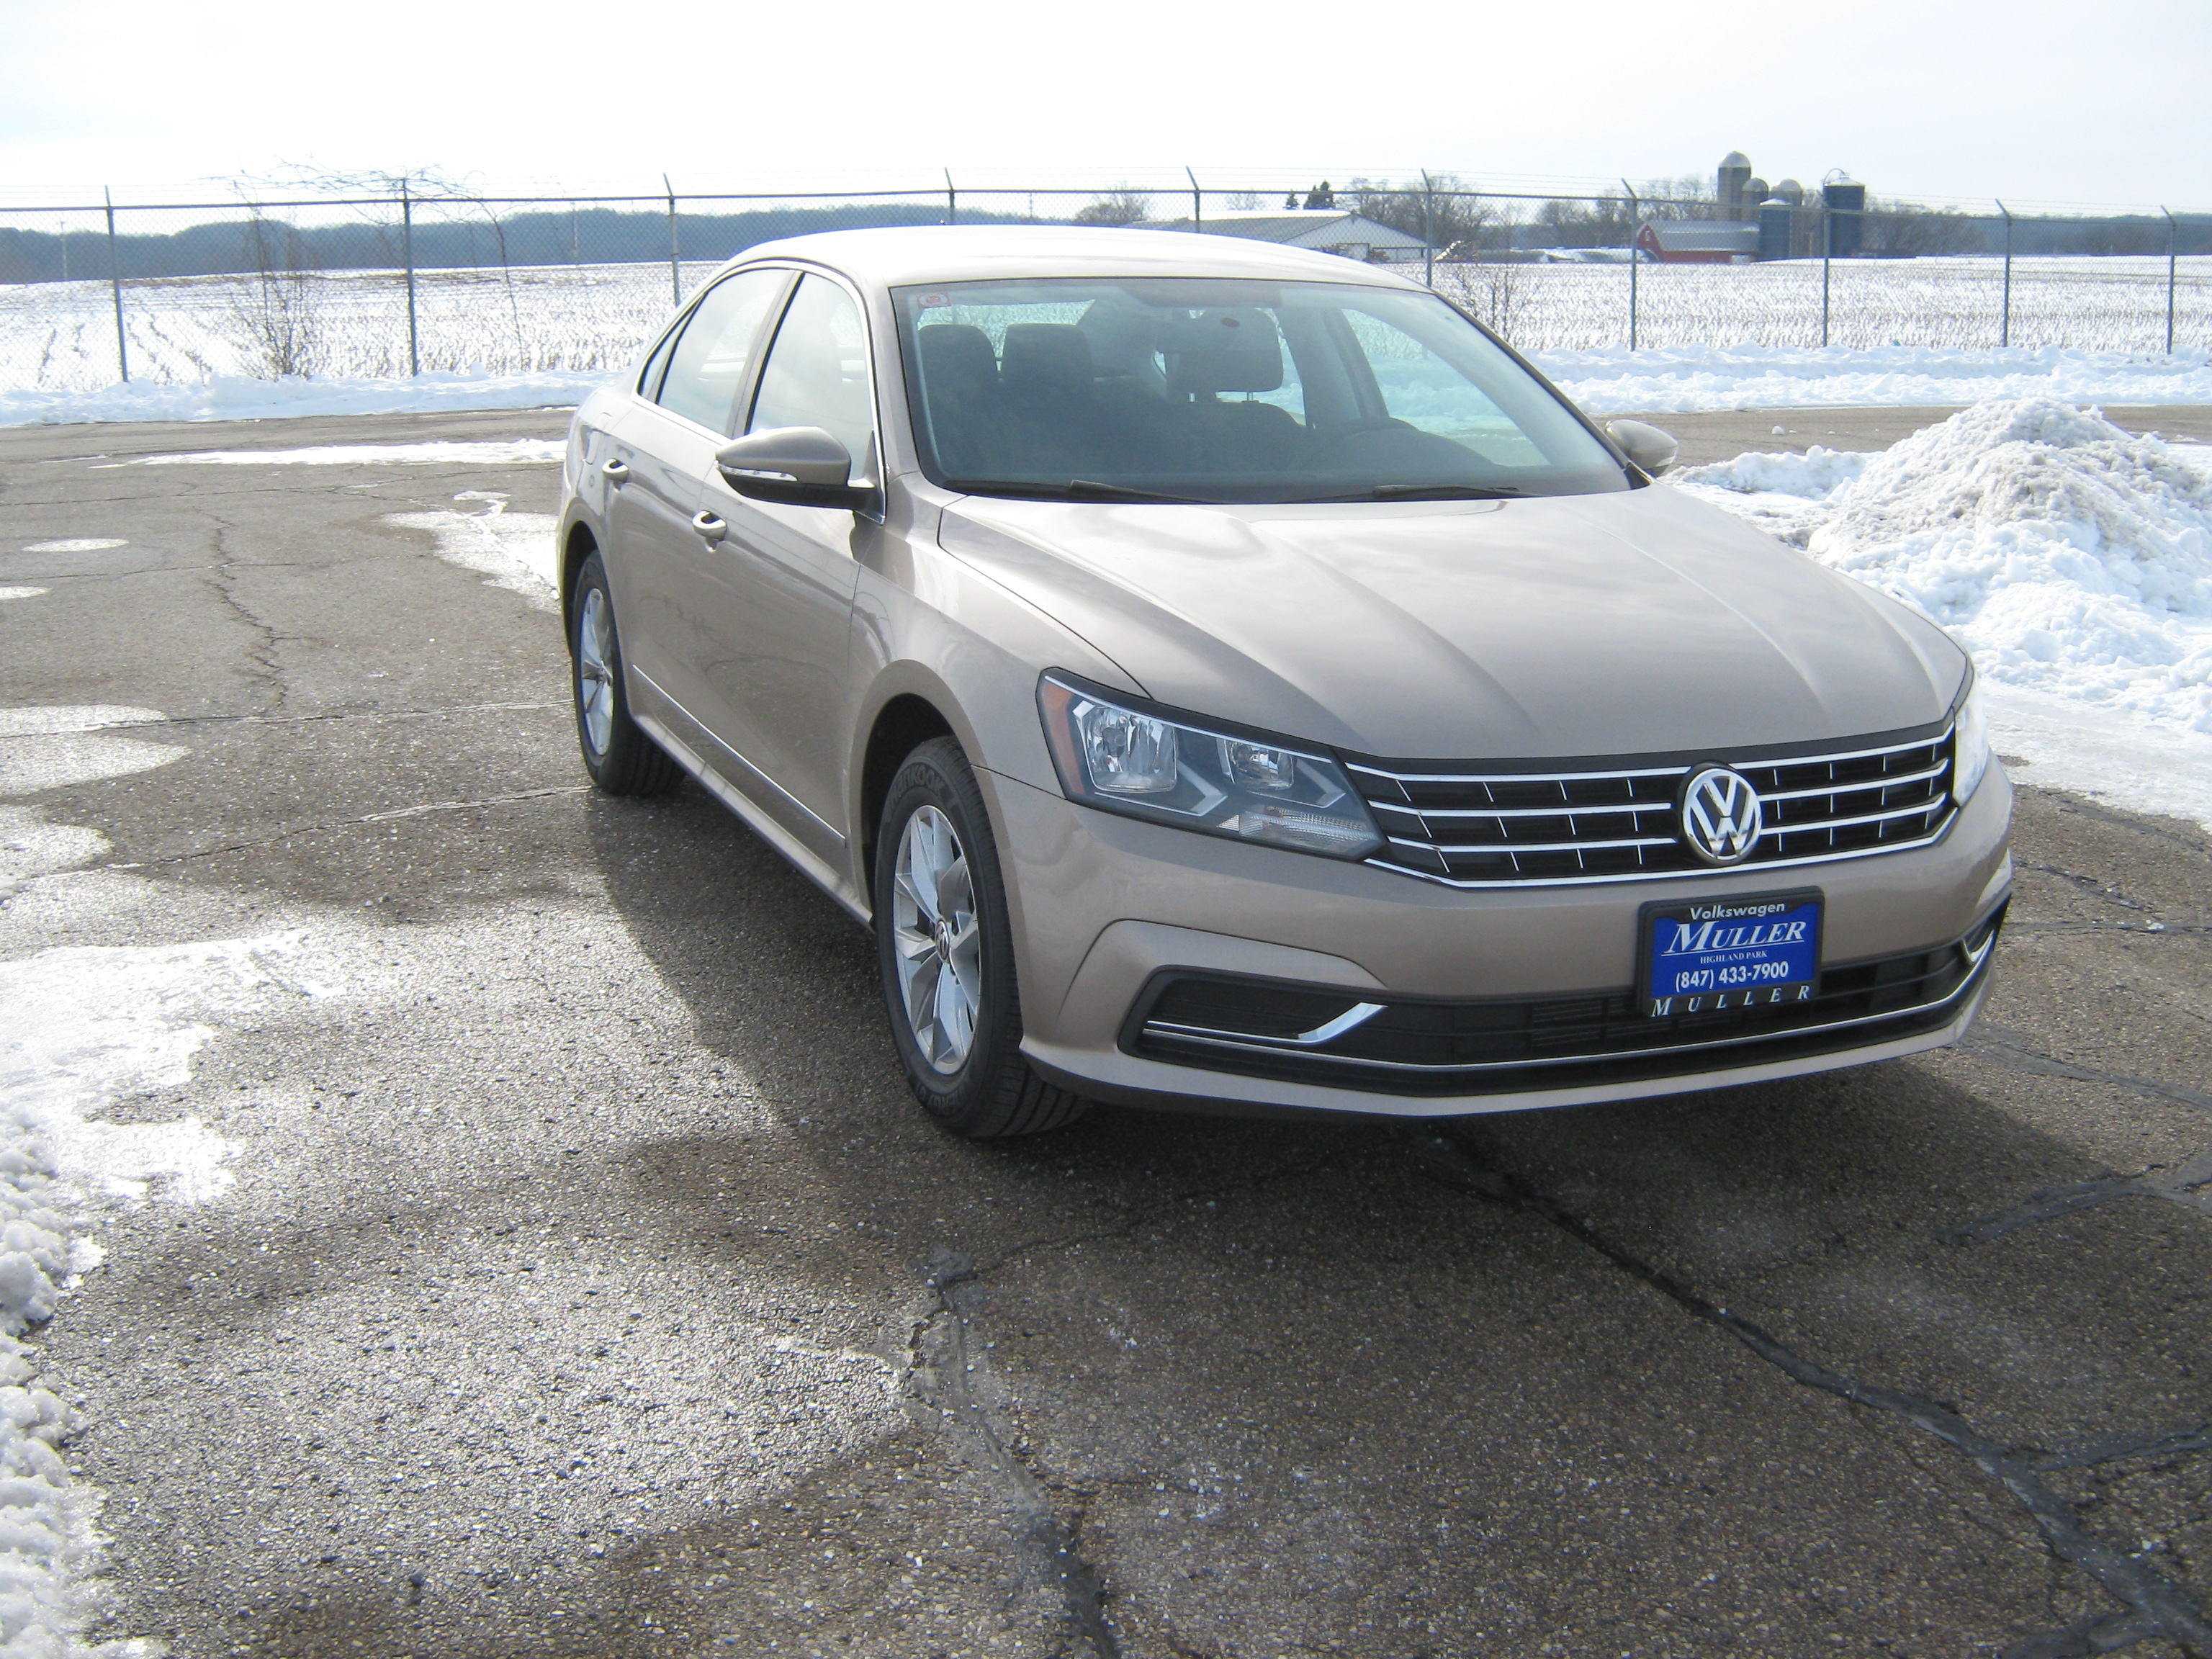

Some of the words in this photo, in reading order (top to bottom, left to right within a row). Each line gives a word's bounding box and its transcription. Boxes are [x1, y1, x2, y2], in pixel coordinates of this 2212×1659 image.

[1690, 903, 1786, 920] Volkswagen
[1663, 920, 1807, 954] MULLER
[1700, 953, 1744, 964] HIGHLAND
[1746, 950, 1768, 959] PARK
[1675, 968, 1714, 992] (847)
[1718, 961, 1789, 985] 433-7900
